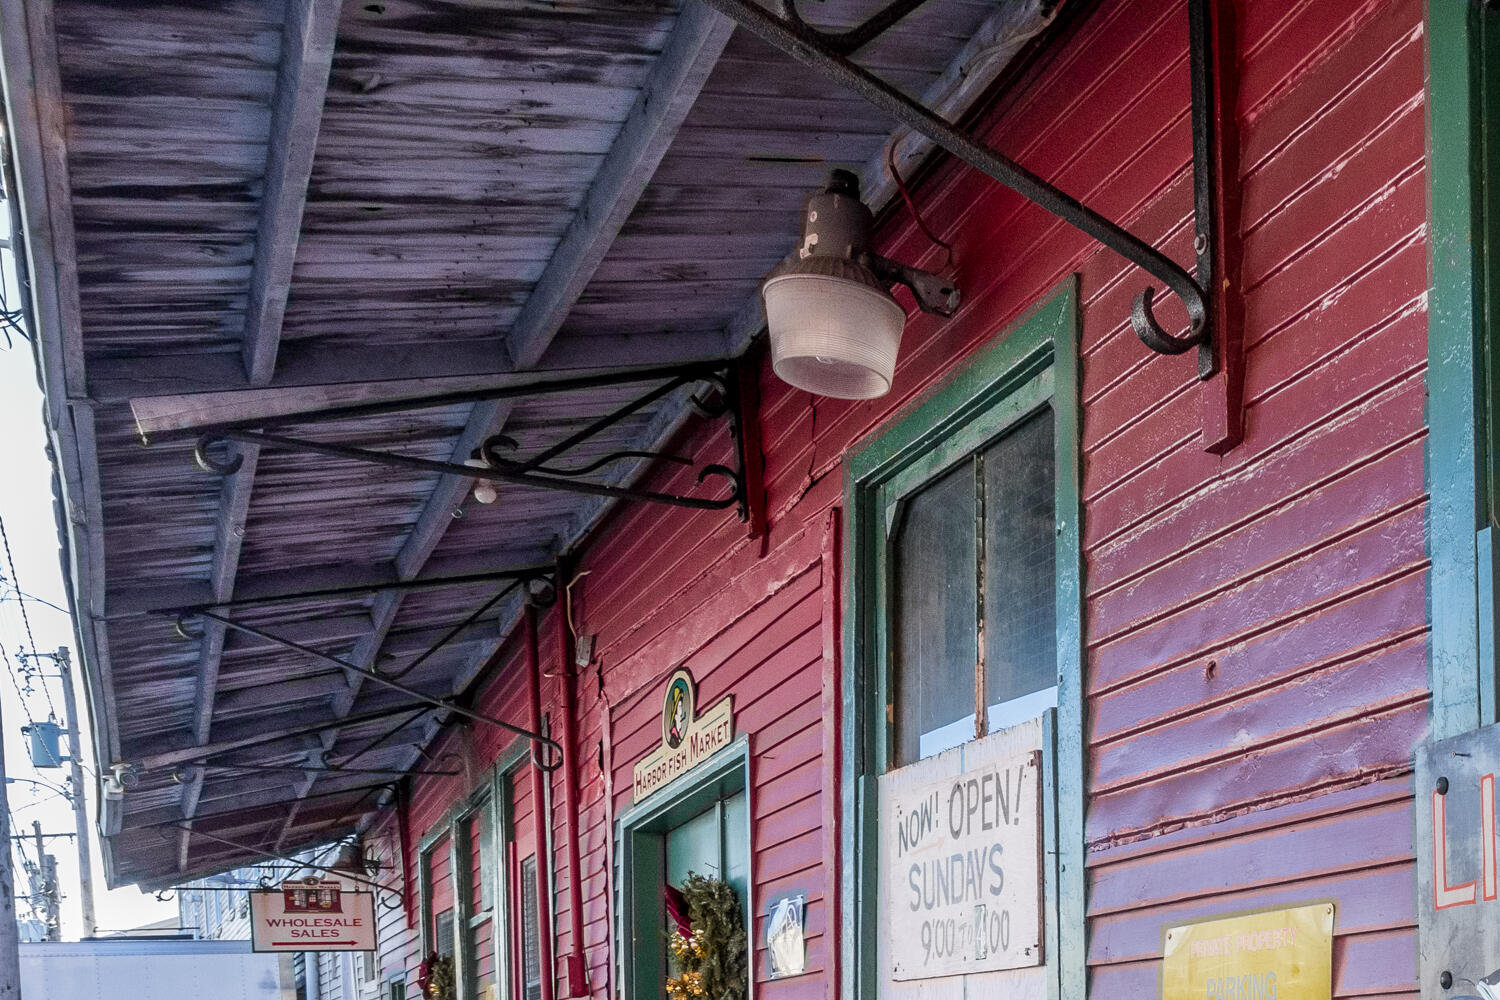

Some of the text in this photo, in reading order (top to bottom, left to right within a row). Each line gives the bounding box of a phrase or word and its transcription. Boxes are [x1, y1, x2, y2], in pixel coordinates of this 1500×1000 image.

[635, 720, 729, 796] HARBOR FISH MARKET
[898, 765, 1024, 858] NOW! OPEN!
[909, 843, 1004, 912] SUNDAYS
[266, 918, 363, 928] WHOLESALE
[291, 929, 340, 938] SALES
[1236, 927, 1298, 952] PROPERTY
